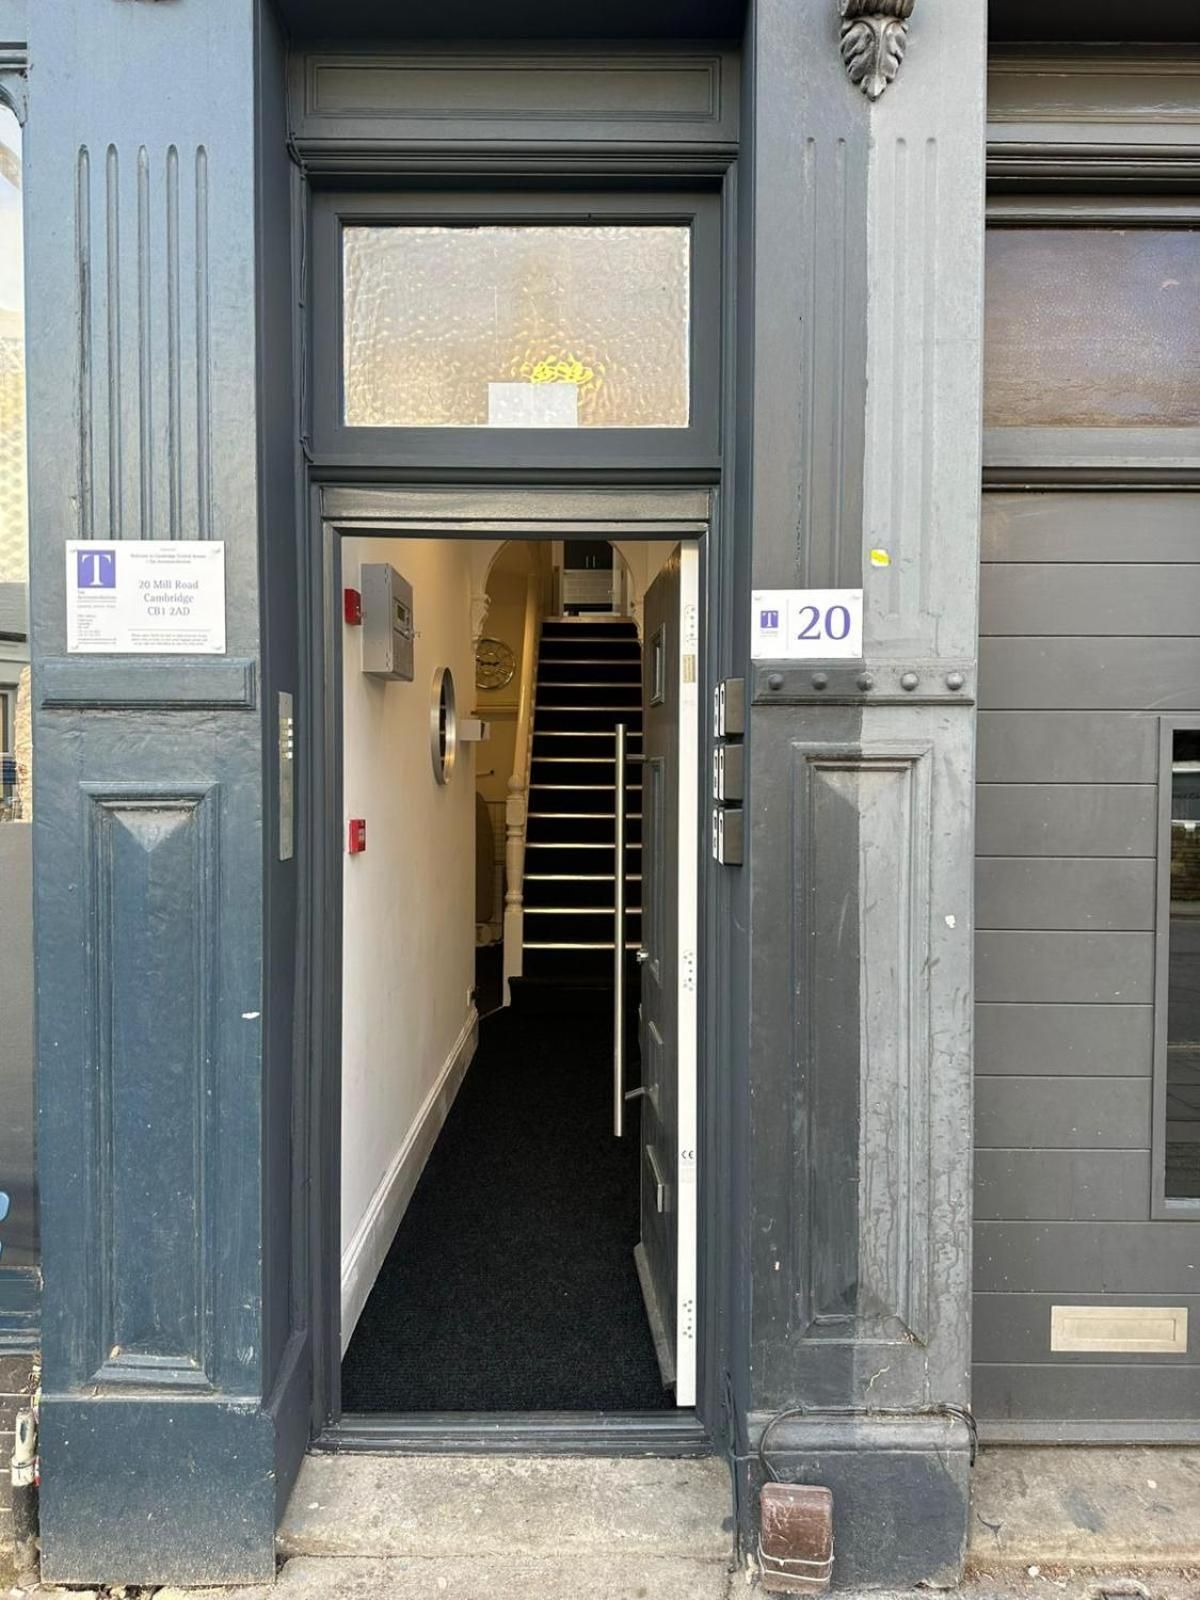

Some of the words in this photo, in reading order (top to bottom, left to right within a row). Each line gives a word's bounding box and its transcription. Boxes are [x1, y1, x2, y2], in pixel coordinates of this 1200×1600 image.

[81, 554, 112, 586] T
[139, 580, 151, 589] 20
[153, 580, 172, 589] Mill
[175, 580, 199, 589] Road
[144, 592, 194, 605] Cambridge
[147, 606, 165, 616] CB1
[169, 606, 190, 616] 2AD
[761, 611, 778, 627] T
[798, 605, 850, 640] 20
